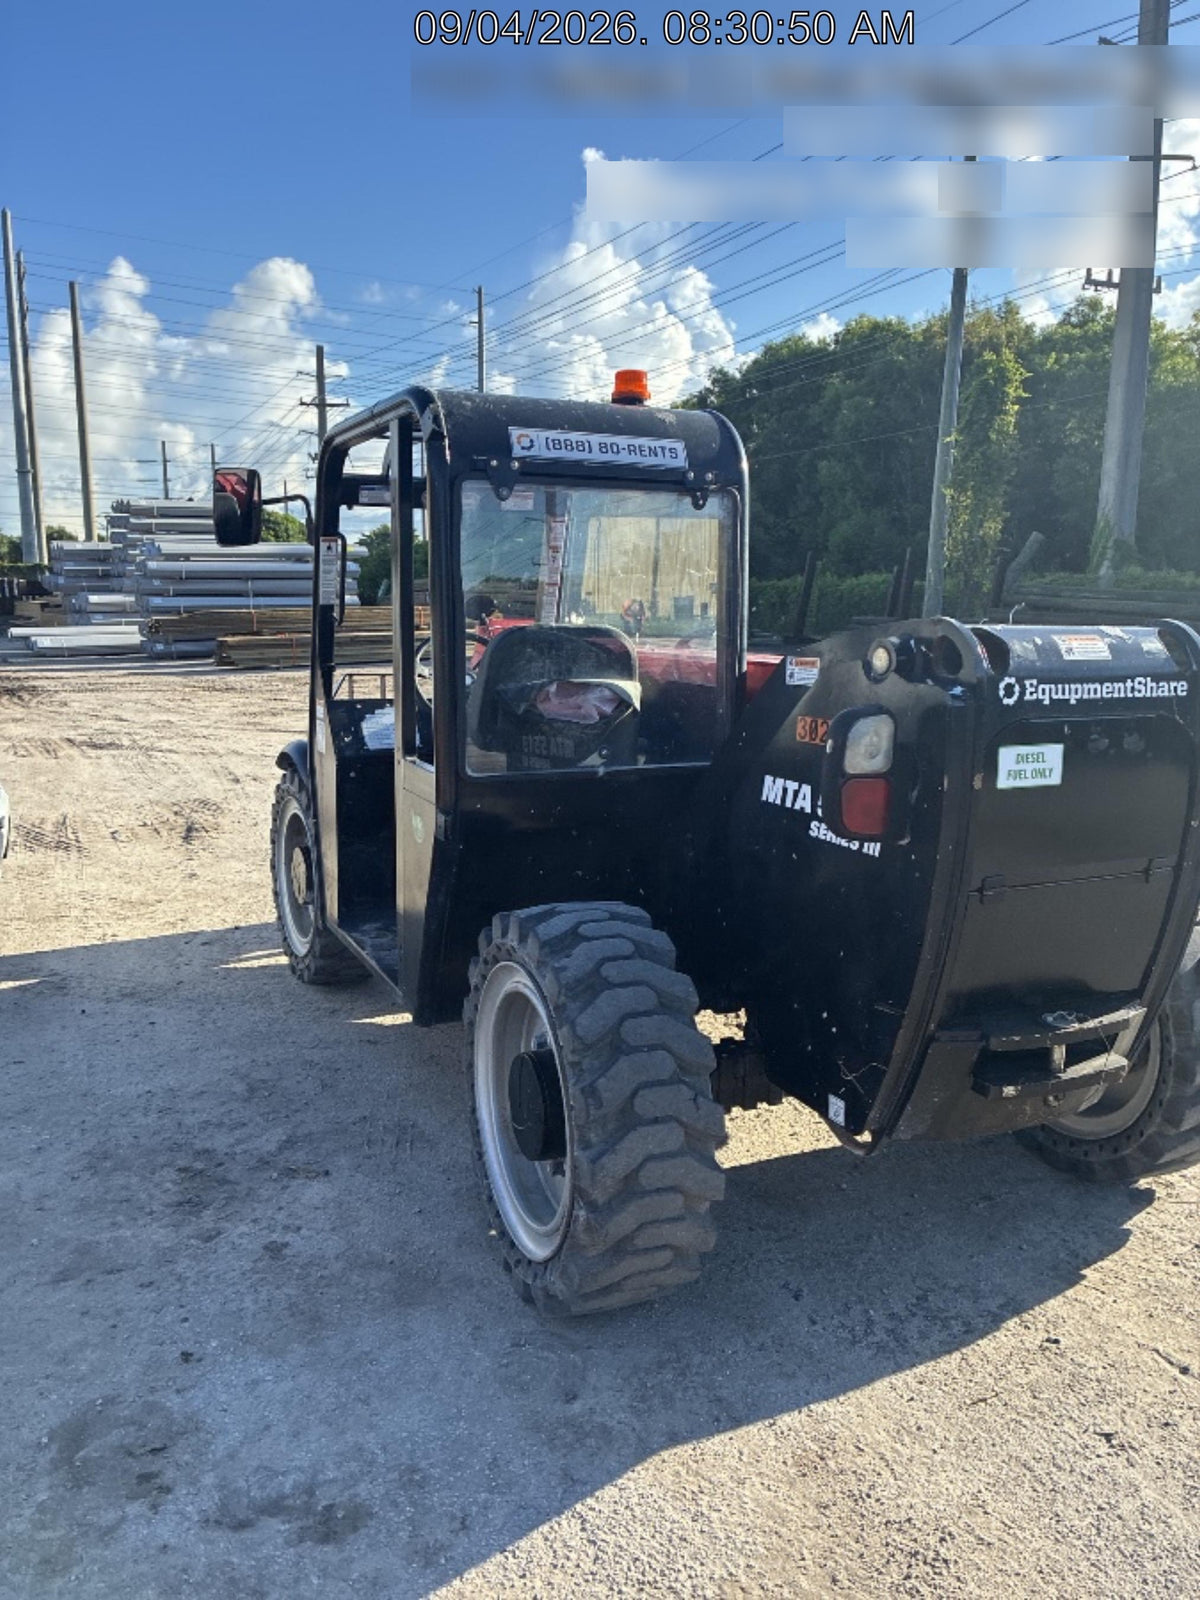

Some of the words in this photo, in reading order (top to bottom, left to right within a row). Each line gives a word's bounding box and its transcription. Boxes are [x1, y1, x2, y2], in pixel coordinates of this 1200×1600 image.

[545, 436, 593, 454] (888)
[598, 442, 678, 460] 80-RENTS
[1023, 676, 1189, 705] EquipmentShare
[1015, 751, 1047, 765] DIESEL
[1006, 769, 1029, 781] FUEL
[1031, 767, 1054, 779] ONLY
[761, 774, 812, 814] MTA
